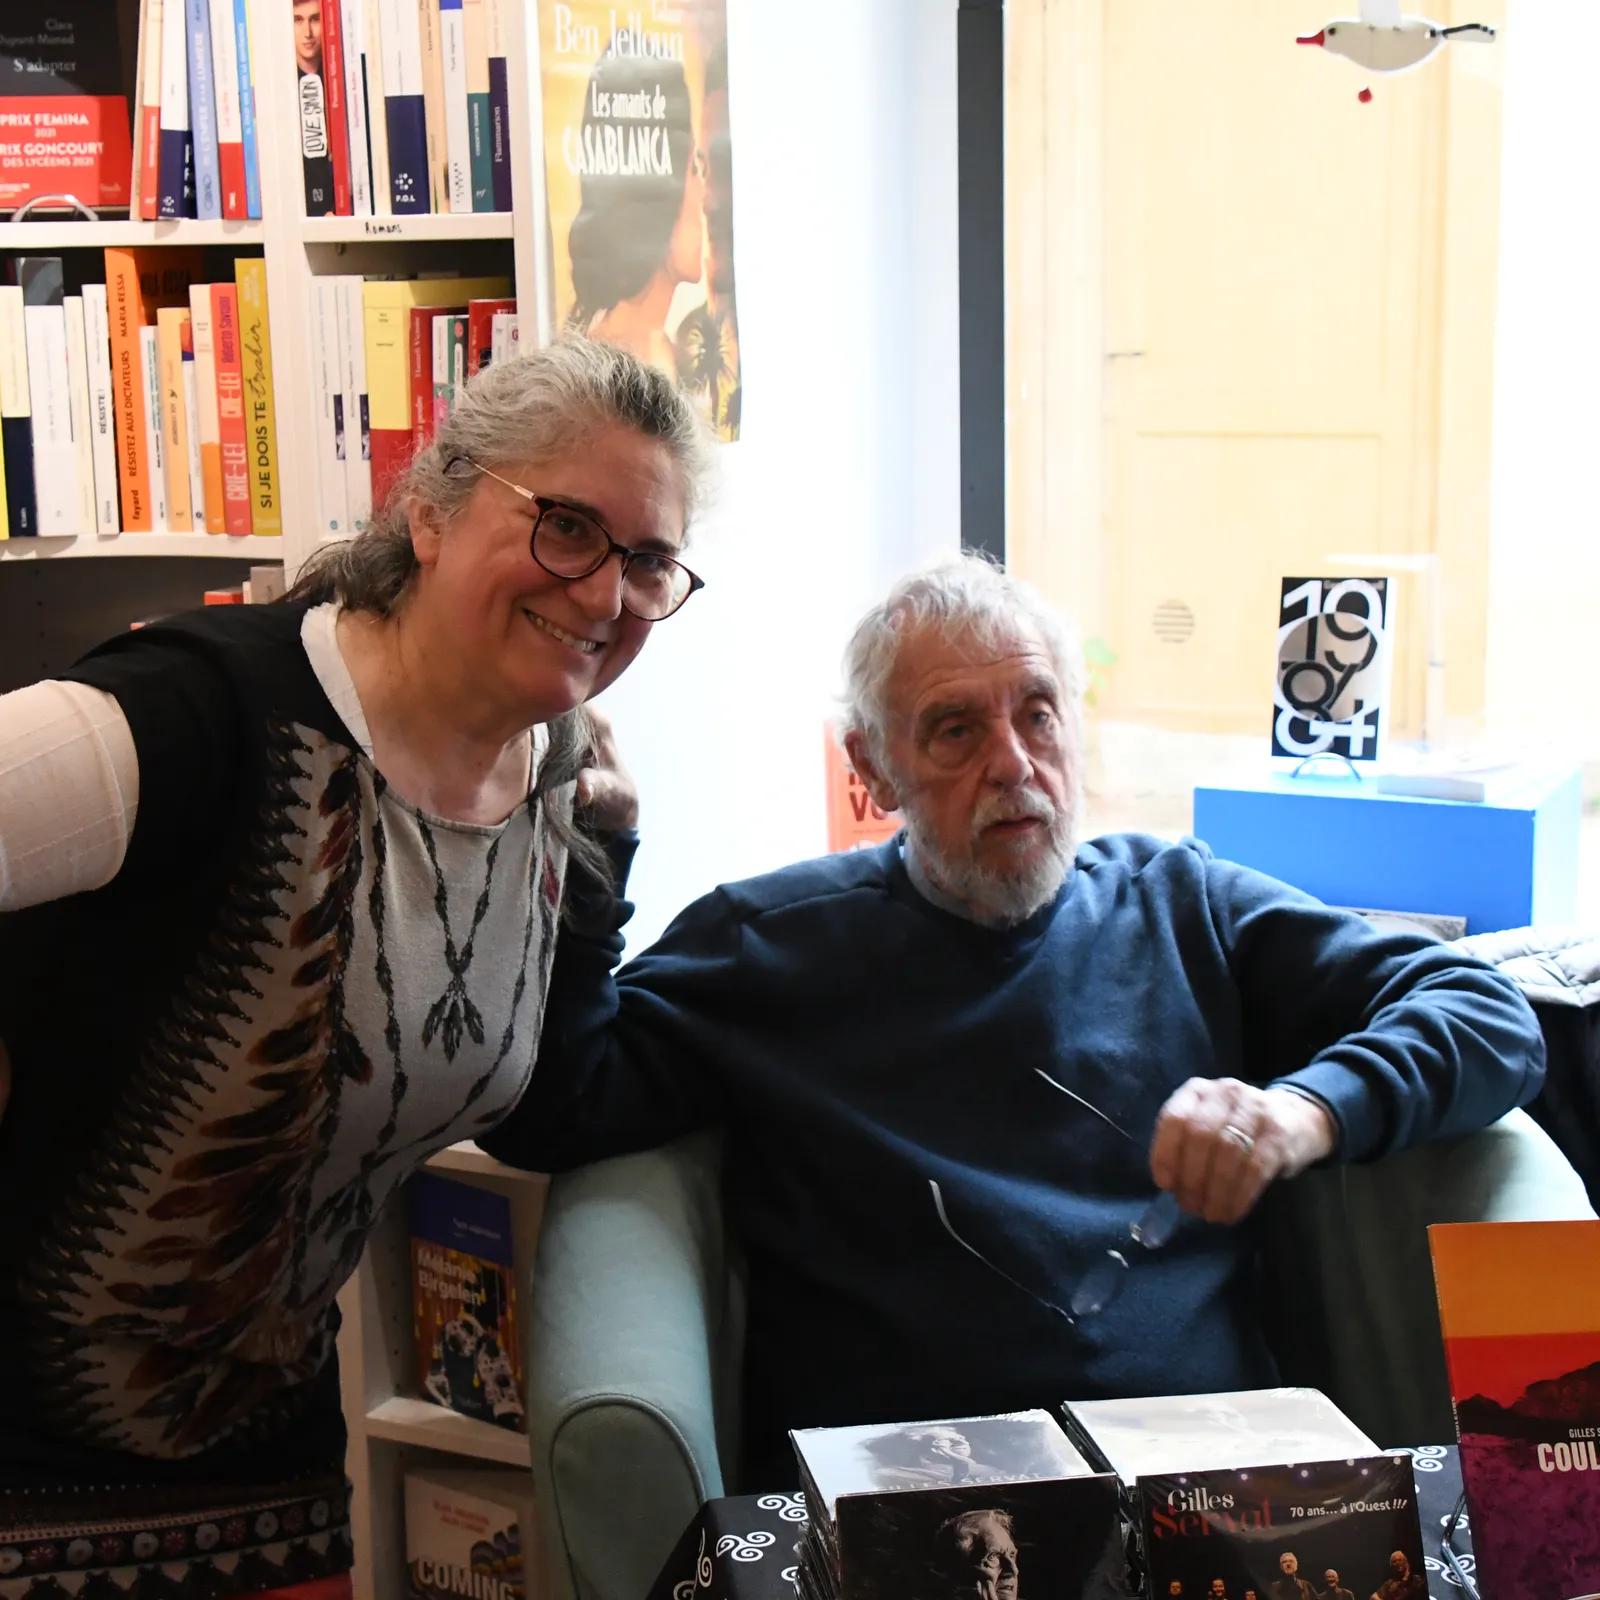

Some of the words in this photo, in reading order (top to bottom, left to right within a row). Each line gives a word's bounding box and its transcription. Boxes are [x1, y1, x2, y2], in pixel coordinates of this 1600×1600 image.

[554, 3, 599, 55] Ben
[606, 9, 684, 62] Jelloun
[13, 57, 77, 77] S'adapter
[302, 80, 324, 115] SIMON
[591, 80, 611, 118] Les
[612, 89, 652, 120] amants
[652, 83, 667, 120] de
[0, 113, 32, 126] PRIX
[34, 112, 89, 126] FEMINA
[494, 106, 503, 163] Flammarion
[23, 142, 104, 156] GONCOURT
[304, 118, 325, 153] LOVE
[562, 124, 674, 176] CASABLANCA
[2, 157, 24, 167] DES
[116, 273, 126, 303] RESSA
[119, 305, 128, 338] MARIA
[245, 318, 268, 395] trahir
[123, 350, 132, 406] DICTATEURS
[99, 394, 107, 435] RÉSISTE
[125, 408, 135, 433] AUX
[253, 402, 266, 423] TE
[127, 435, 138, 477] RÉSISTEZ
[256, 426, 270, 467] DOIS
[258, 472, 271, 491] JE
[132, 489, 140, 520] fayard
[260, 492, 272, 509] SI
[1451, 1396, 1462, 1444] COULEURS
[1568, 1427, 1595, 1439] GILLES
[1167, 1487, 1234, 1513] Gilles
[1290, 1506, 1304, 1518] 70
[1307, 1505, 1338, 1518] ans...
[1340, 1502, 1348, 1515] à
[1350, 1499, 1391, 1515] l'Ouest
[1392, 1498, 1408, 1510] !!!
